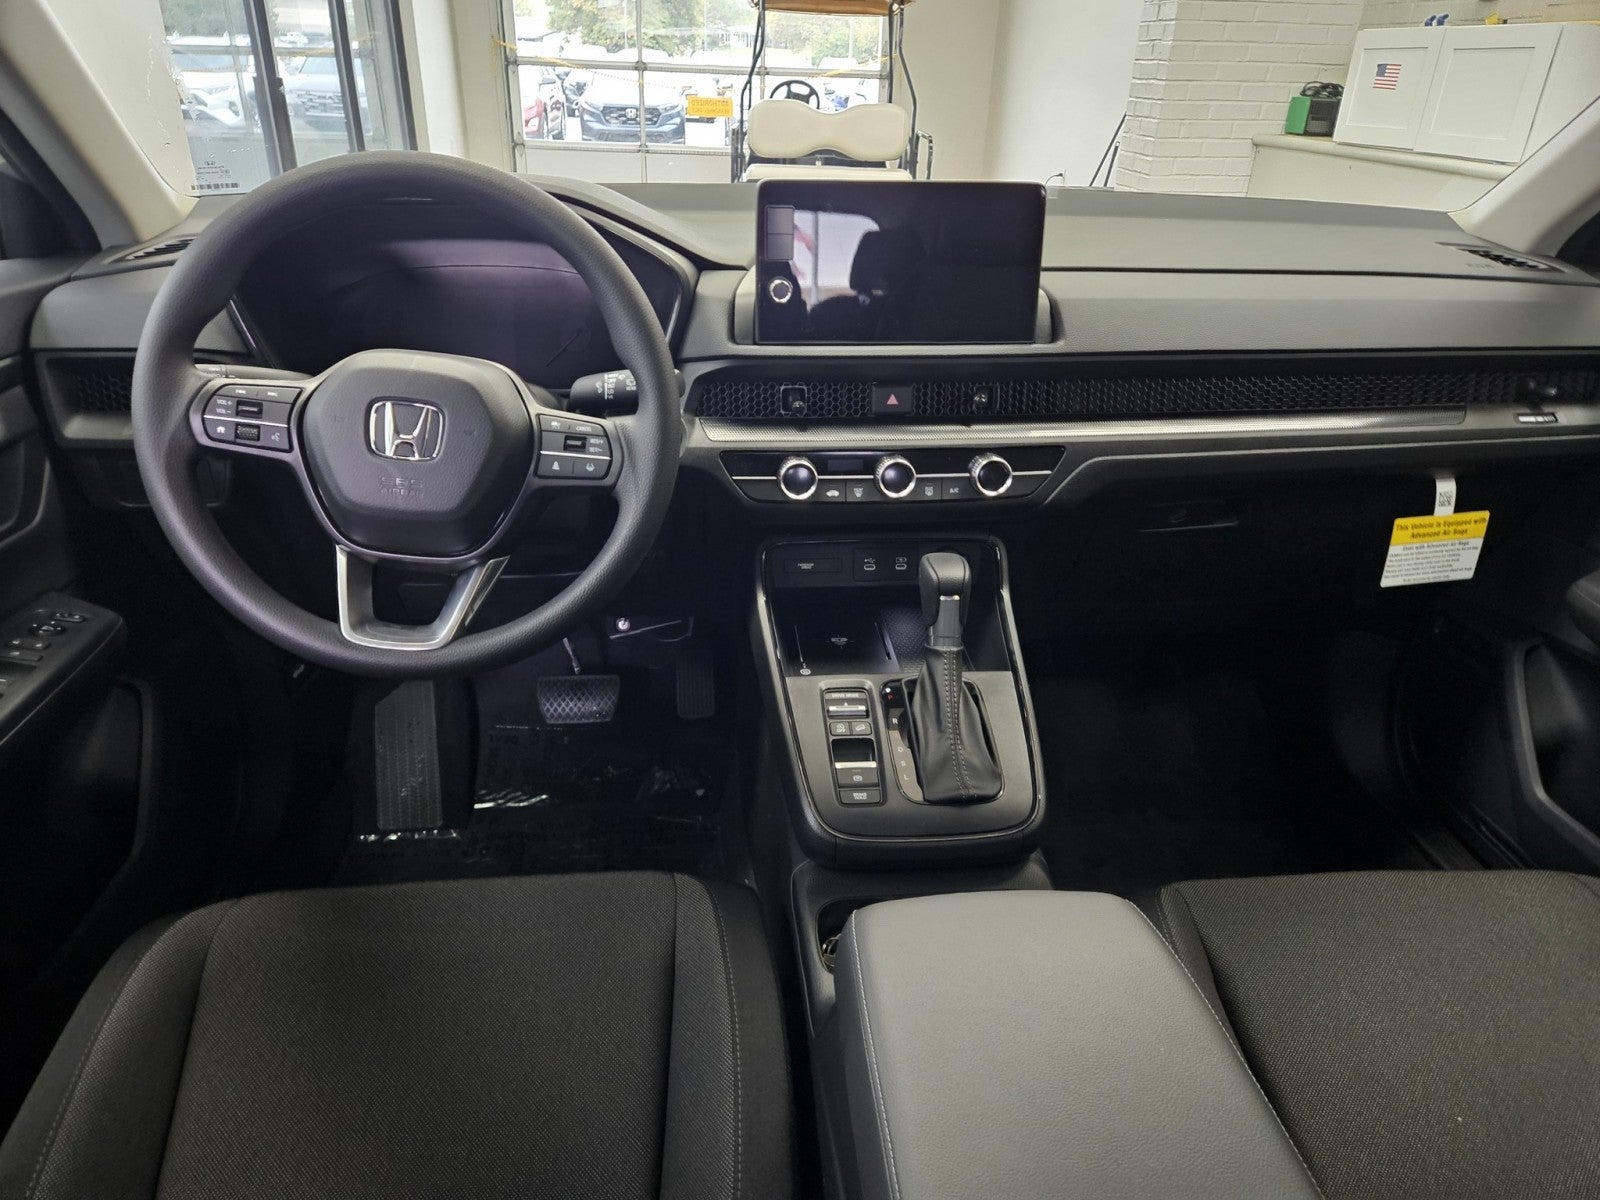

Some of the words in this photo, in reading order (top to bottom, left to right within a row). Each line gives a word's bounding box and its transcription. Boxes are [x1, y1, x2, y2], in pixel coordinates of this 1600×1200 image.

[1396, 523, 1409, 531] This
[1411, 522, 1435, 530] Vehicle
[1443, 519, 1472, 528] Equipped
[1411, 530, 1441, 538] Advanced
[1453, 528, 1468, 537] Bags
